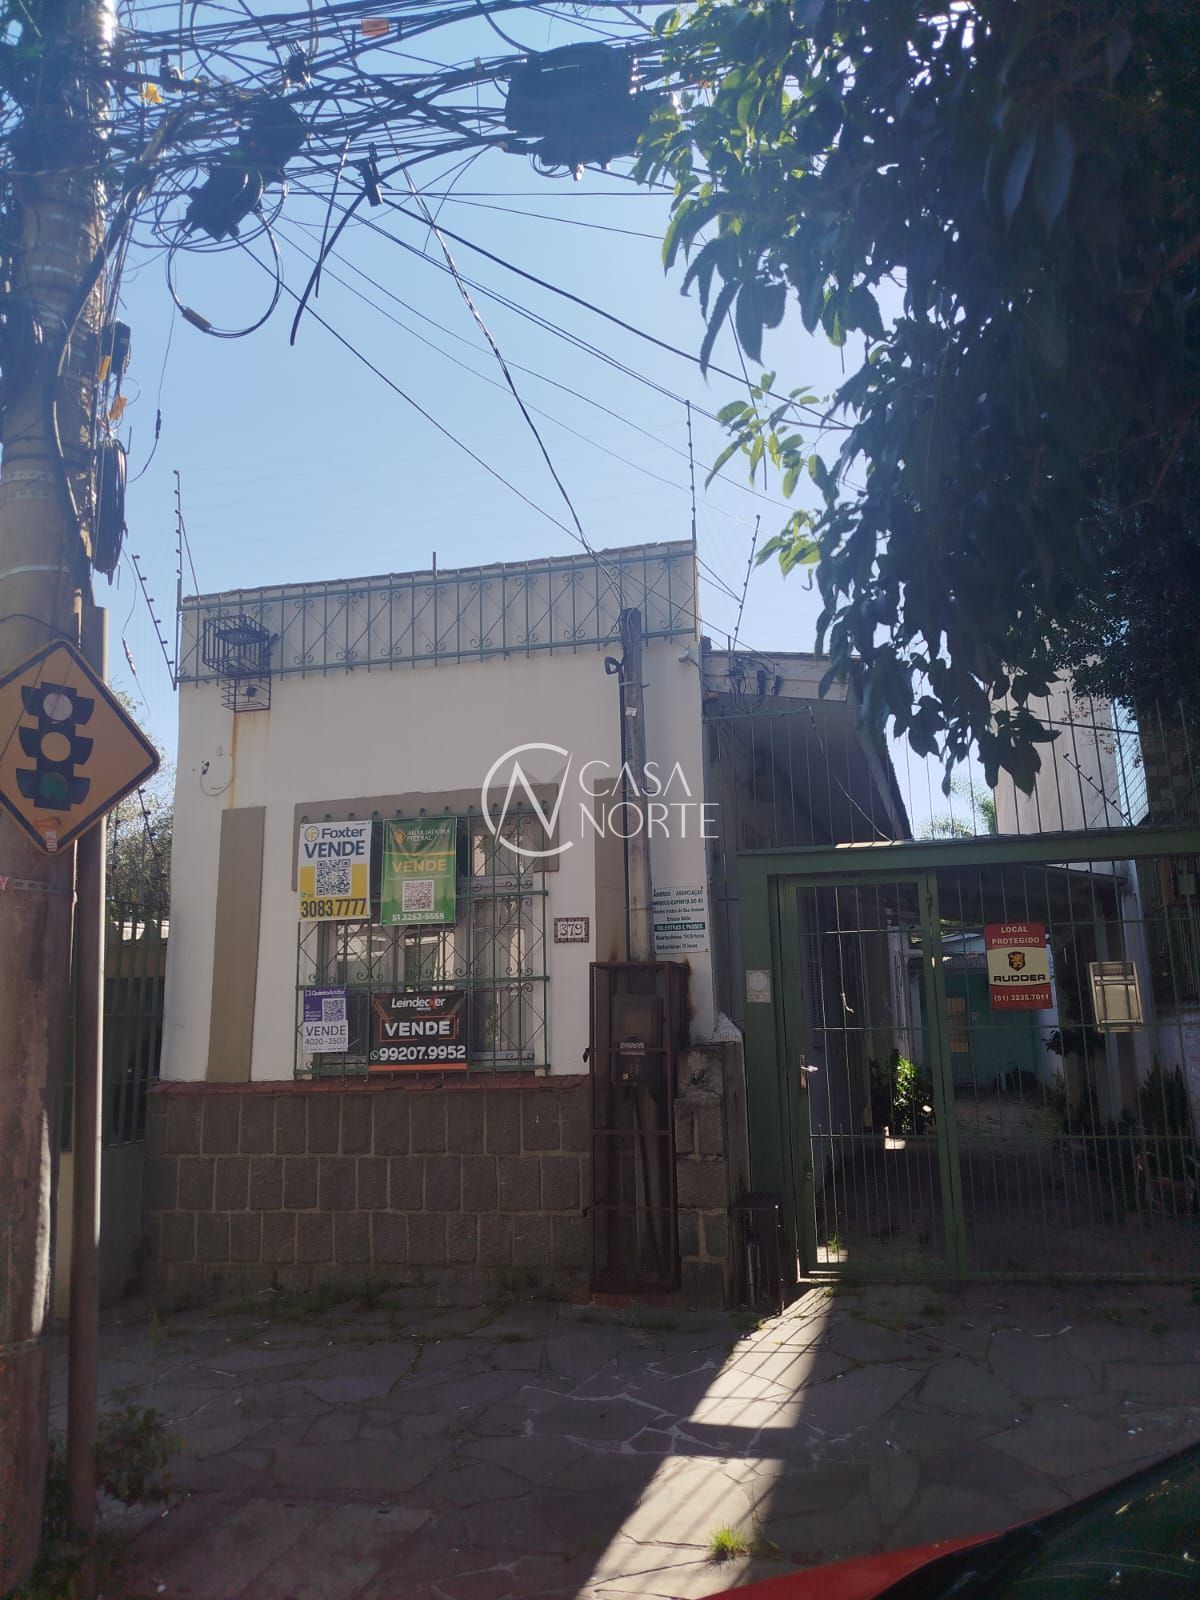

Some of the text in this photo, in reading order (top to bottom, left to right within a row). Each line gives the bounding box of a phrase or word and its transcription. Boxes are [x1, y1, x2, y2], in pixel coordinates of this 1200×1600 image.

[321, 828, 366, 839] Foxter
[304, 840, 365, 859] VENDE
[392, 859, 447, 873] VENDE
[301, 898, 367, 918] 3083.7777
[560, 923, 583, 937] 379
[993, 974, 1046, 982] RUDDER
[391, 997, 446, 1009] Leindecker
[306, 1025, 346, 1037] VENDE
[385, 1021, 451, 1037] VENDE
[305, 1038, 346, 1046] 4020-2507
[379, 1046, 466, 1061] 99207.9952
